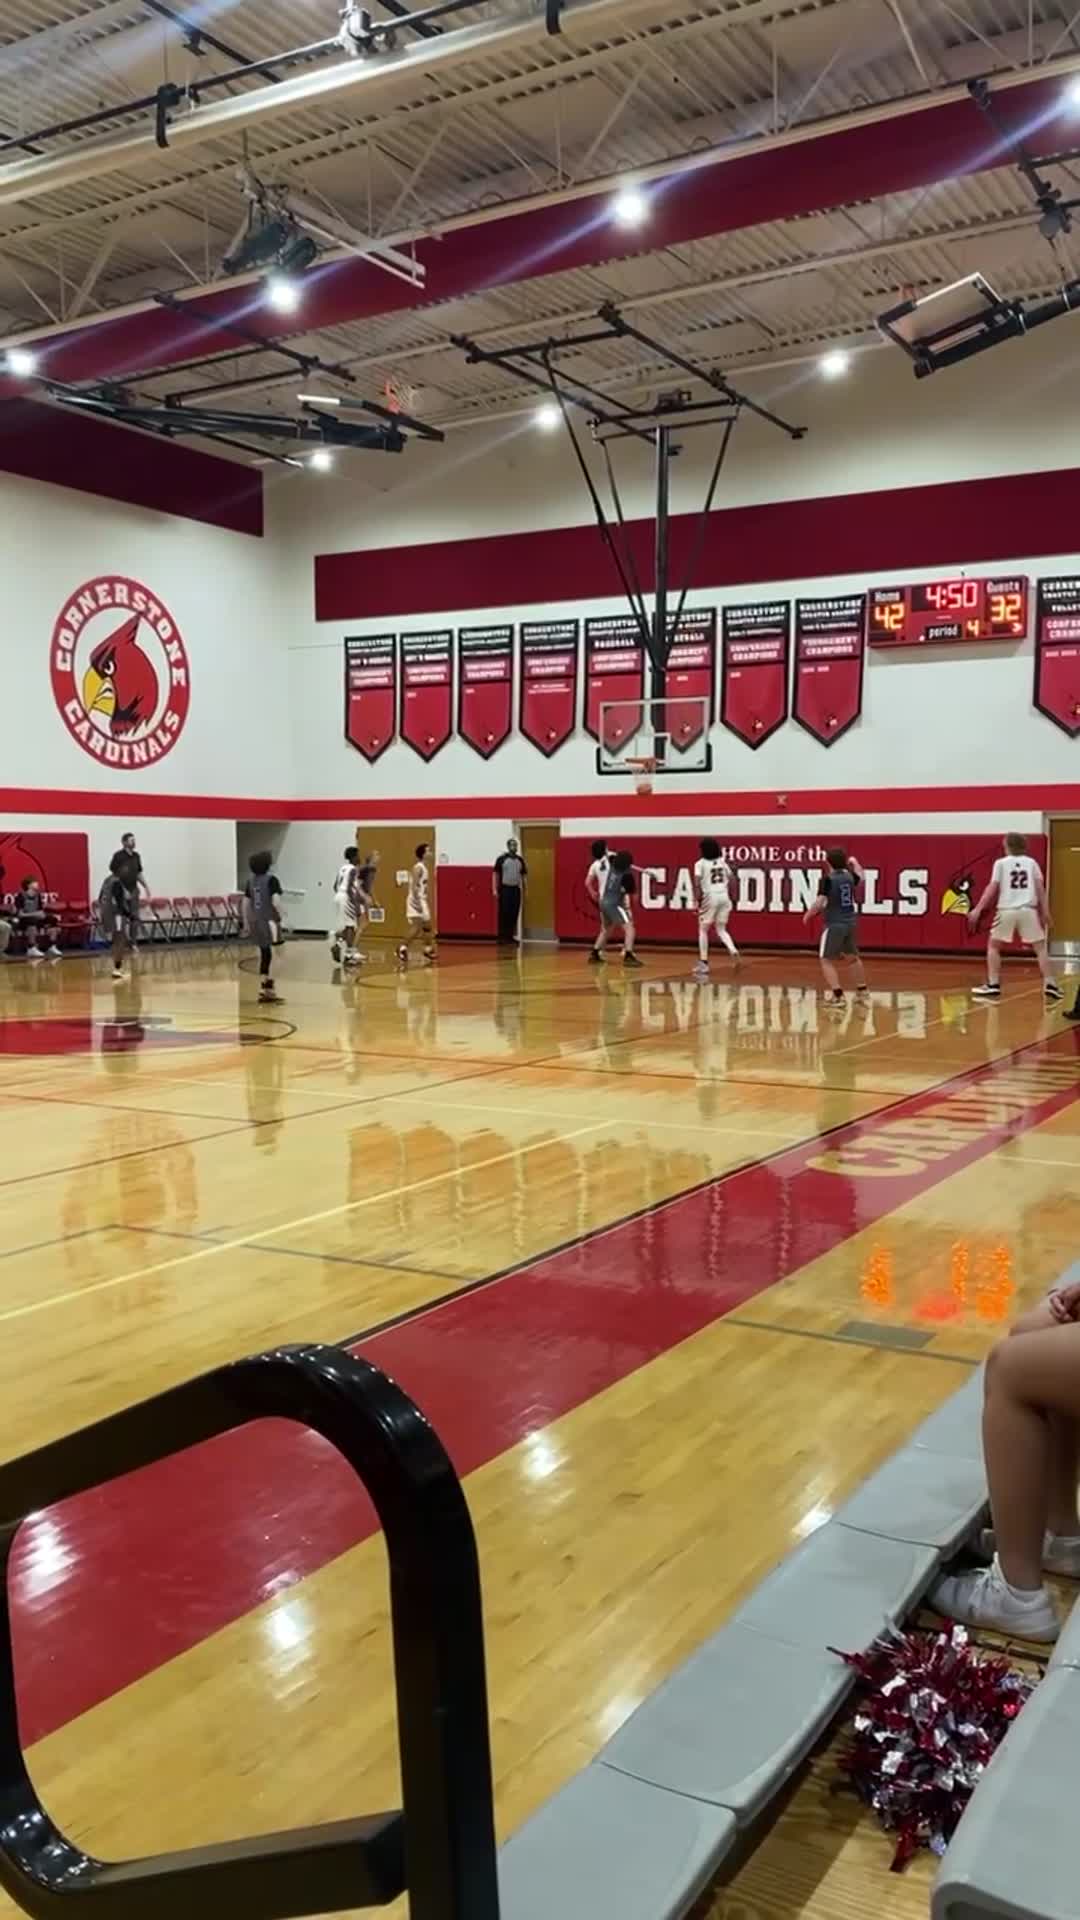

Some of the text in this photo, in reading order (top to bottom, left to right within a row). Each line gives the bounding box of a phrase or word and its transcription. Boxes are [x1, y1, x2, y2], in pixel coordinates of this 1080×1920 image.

[875, 591, 900, 602] Home
[926, 582, 978, 609] 4:50
[986, 580, 1020, 594] Guests
[874, 603, 905, 630] 42
[991, 594, 1021, 622] 32
[56, 583, 187, 687] CORNERSTONE
[929, 619, 980, 639] period 4
[64, 697, 180, 765] CARDINALS
[722, 845, 828, 861] HOME of th
[710, 868, 724, 884] 25
[1010, 871, 1028, 889] 22
[639, 867, 928, 915] CADINLS
